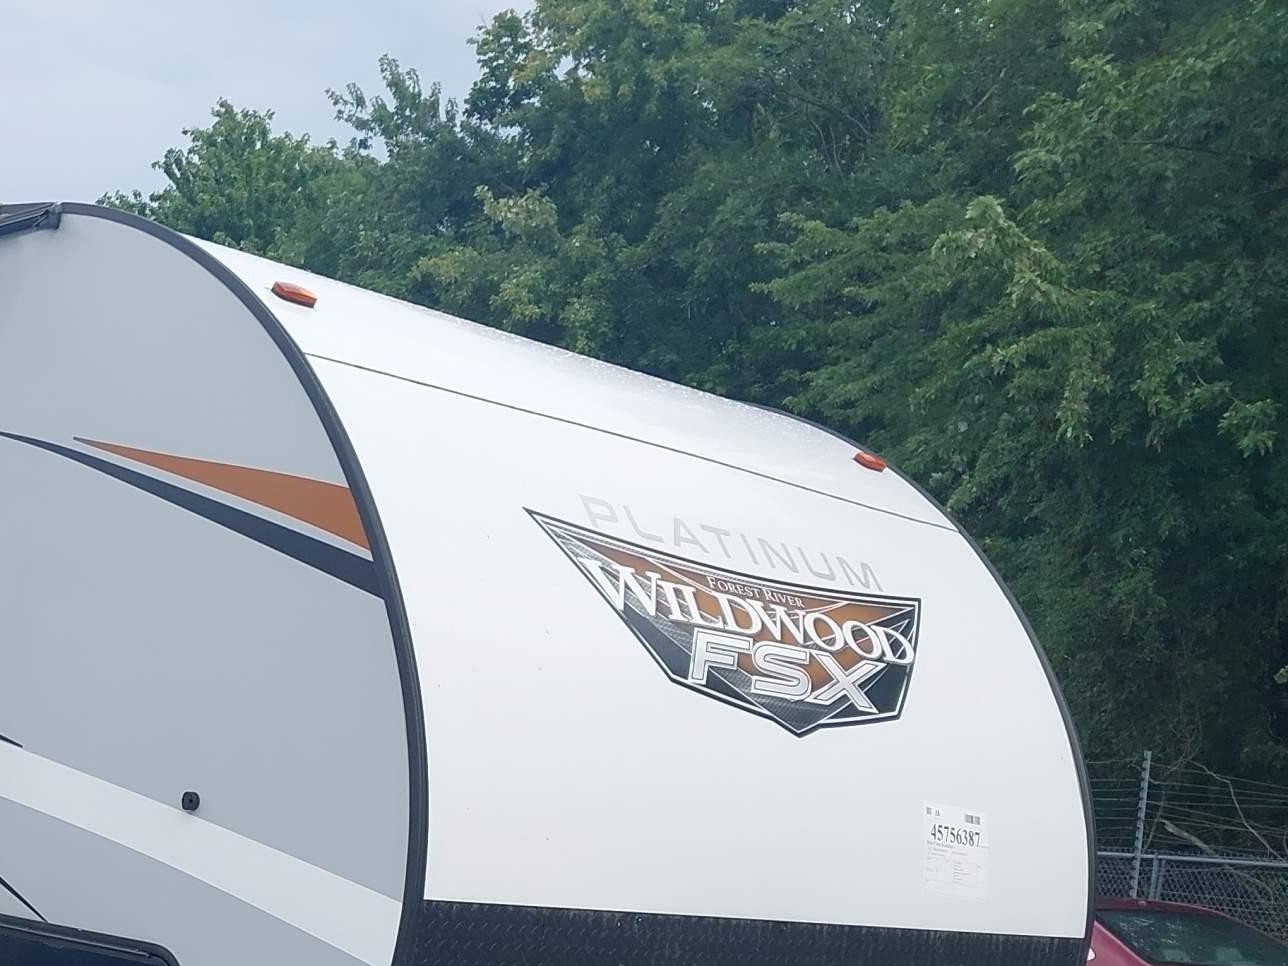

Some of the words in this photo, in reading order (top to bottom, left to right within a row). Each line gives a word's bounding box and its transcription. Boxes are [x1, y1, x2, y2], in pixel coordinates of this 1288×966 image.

[579, 494, 884, 592] PLATINUM
[577, 557, 914, 665] WILDWOOD
[706, 575, 760, 598] FOREST
[763, 588, 806, 608] RIVER
[688, 626, 887, 713] FSX
[930, 824, 981, 847] 45756387
